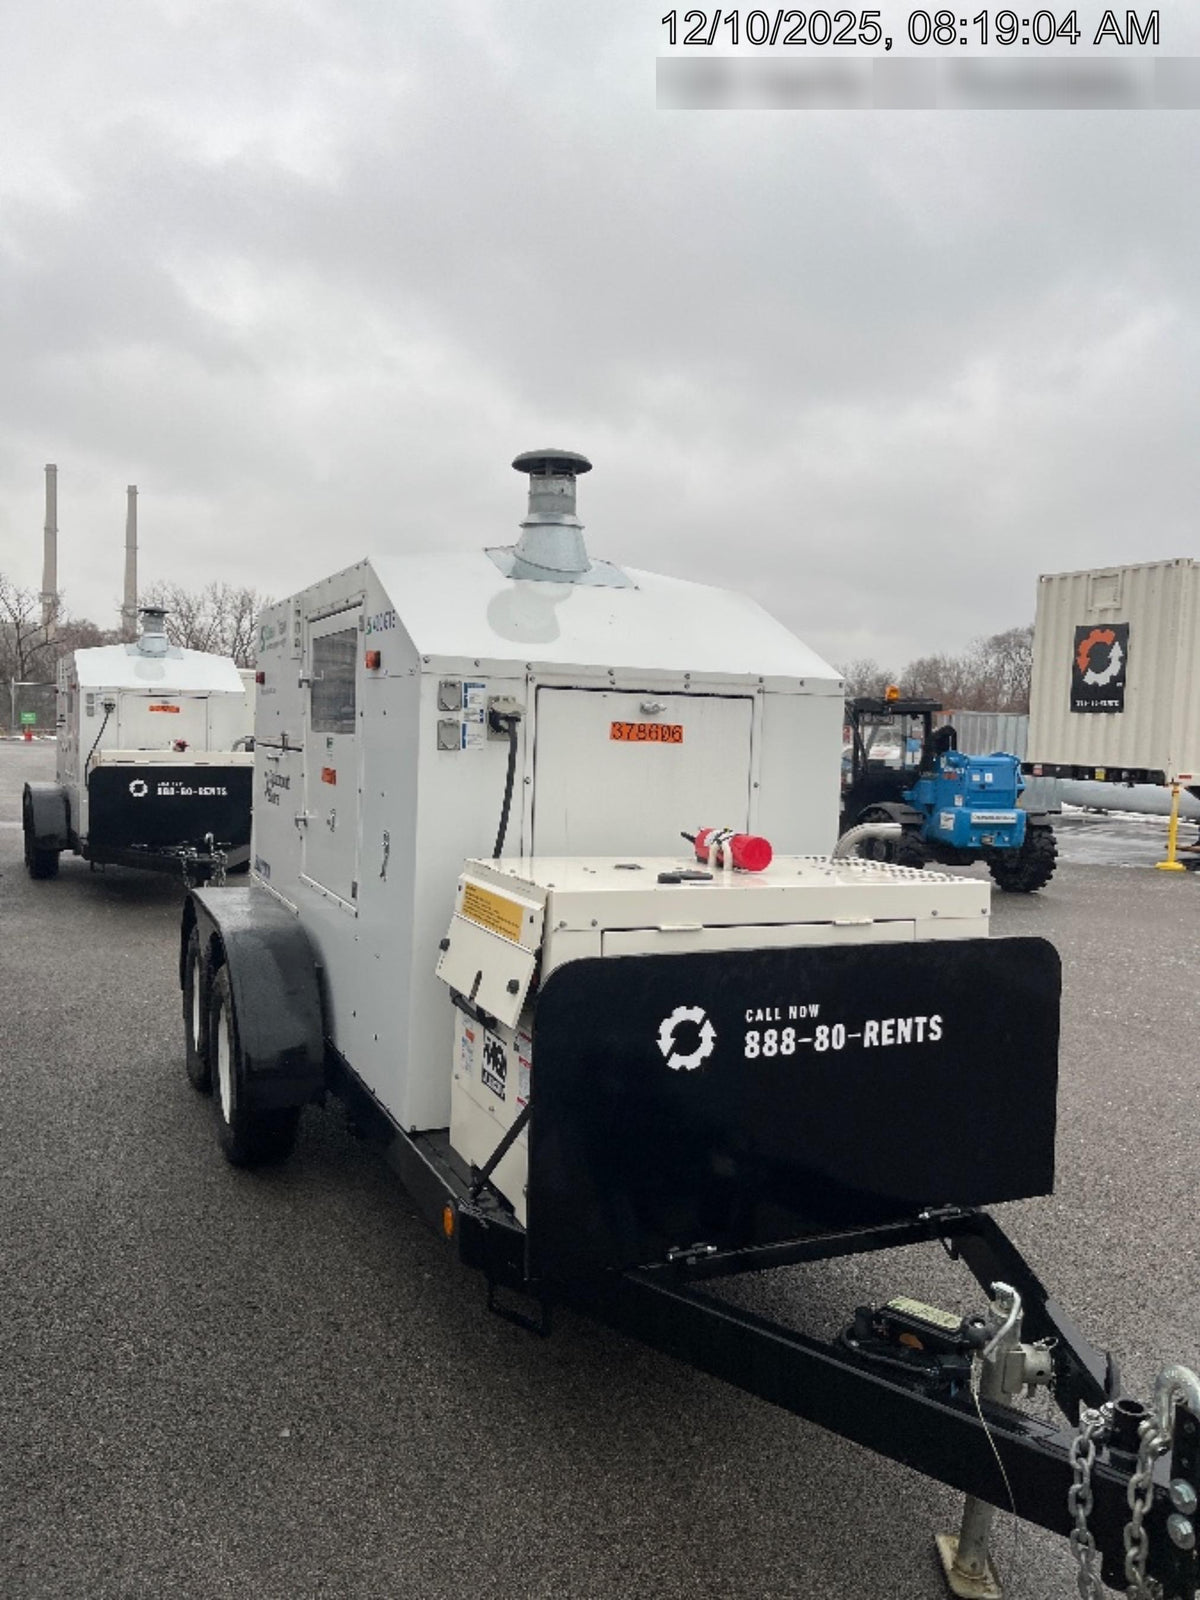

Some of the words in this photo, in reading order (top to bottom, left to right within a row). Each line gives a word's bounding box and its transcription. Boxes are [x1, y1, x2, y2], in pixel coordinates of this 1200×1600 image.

[745, 1008, 782, 1023] CALL
[788, 1004, 821, 1019] NOW
[744, 1014, 944, 1059] 888-80-RENTS
